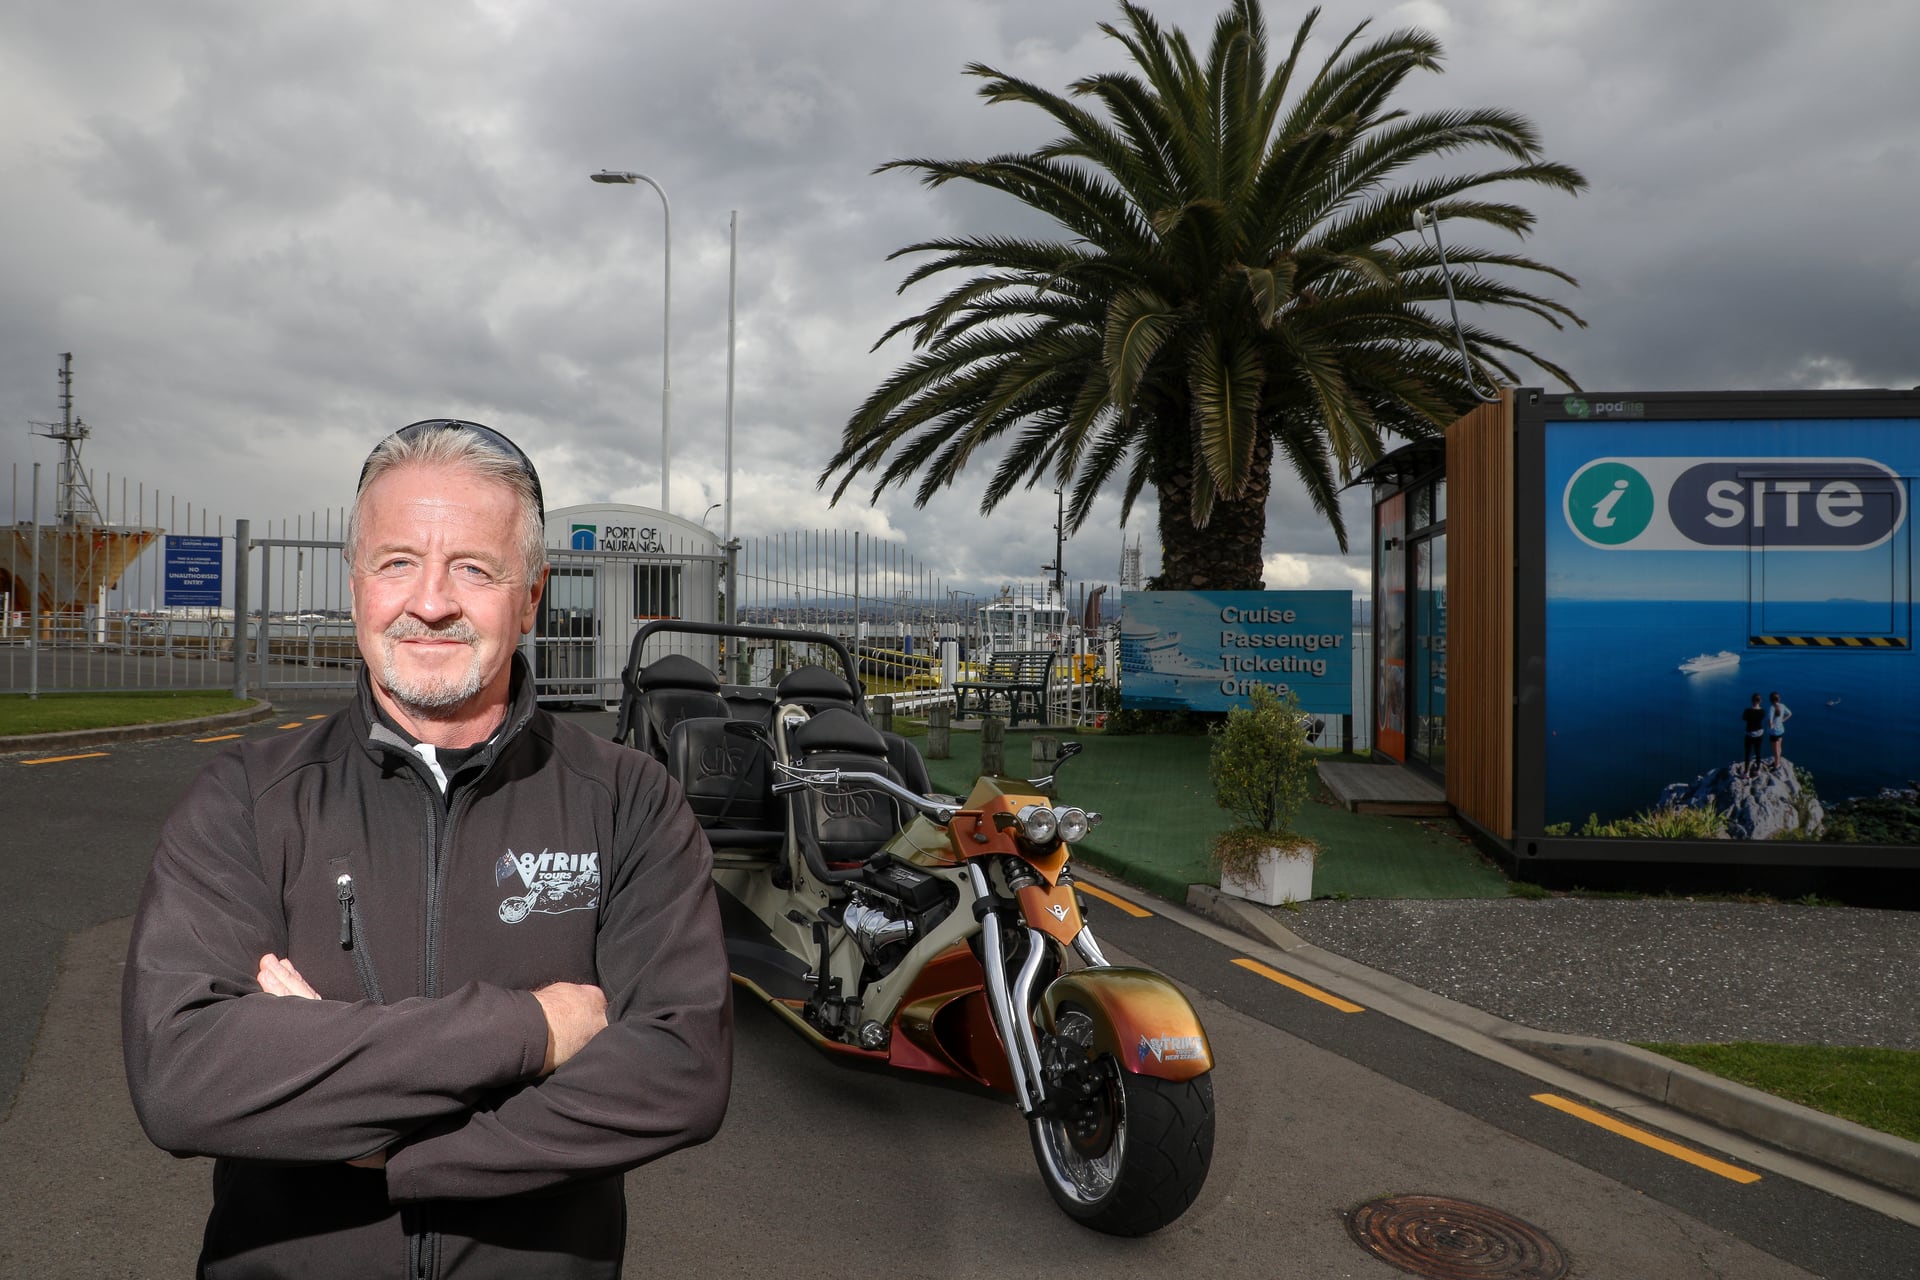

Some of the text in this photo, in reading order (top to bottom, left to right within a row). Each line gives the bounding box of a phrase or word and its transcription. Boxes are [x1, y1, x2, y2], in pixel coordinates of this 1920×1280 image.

[1592, 479, 1629, 528] i
[605, 526, 657, 540] PORT OF
[599, 539, 665, 553] TAURANGA
[1221, 606, 1296, 624] Cruise
[1221, 630, 1344, 652] Passenger
[1220, 654, 1327, 677] Ticketing
[1220, 679, 1290, 697] Offce
[538, 852, 600, 872] TRIK
[538, 872, 572, 880] TOURS
[1044, 904, 1070, 922] V8
